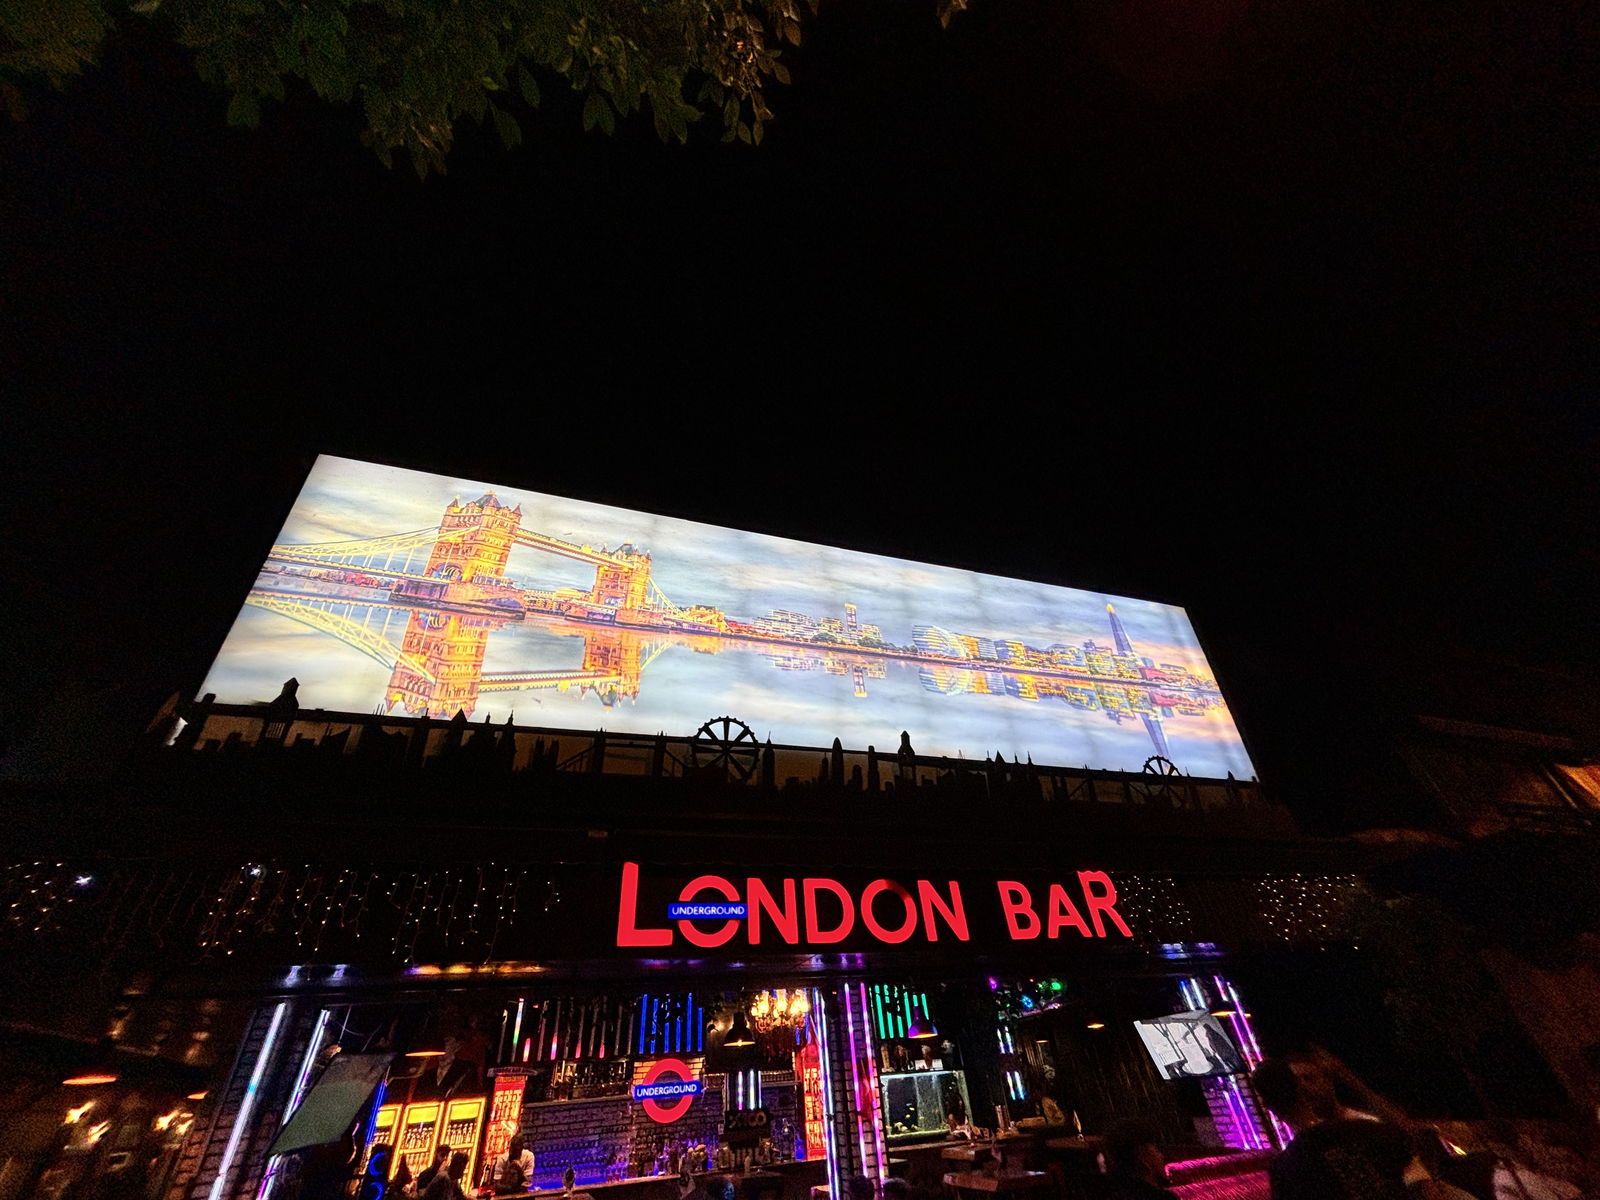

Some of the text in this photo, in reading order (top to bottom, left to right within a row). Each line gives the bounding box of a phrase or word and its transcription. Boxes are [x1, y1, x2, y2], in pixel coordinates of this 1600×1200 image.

[617, 862, 1133, 947] LONDON BAR
[671, 906, 745, 916] UNDERGROUND
[636, 1084, 697, 1097] UNDERGROUND
